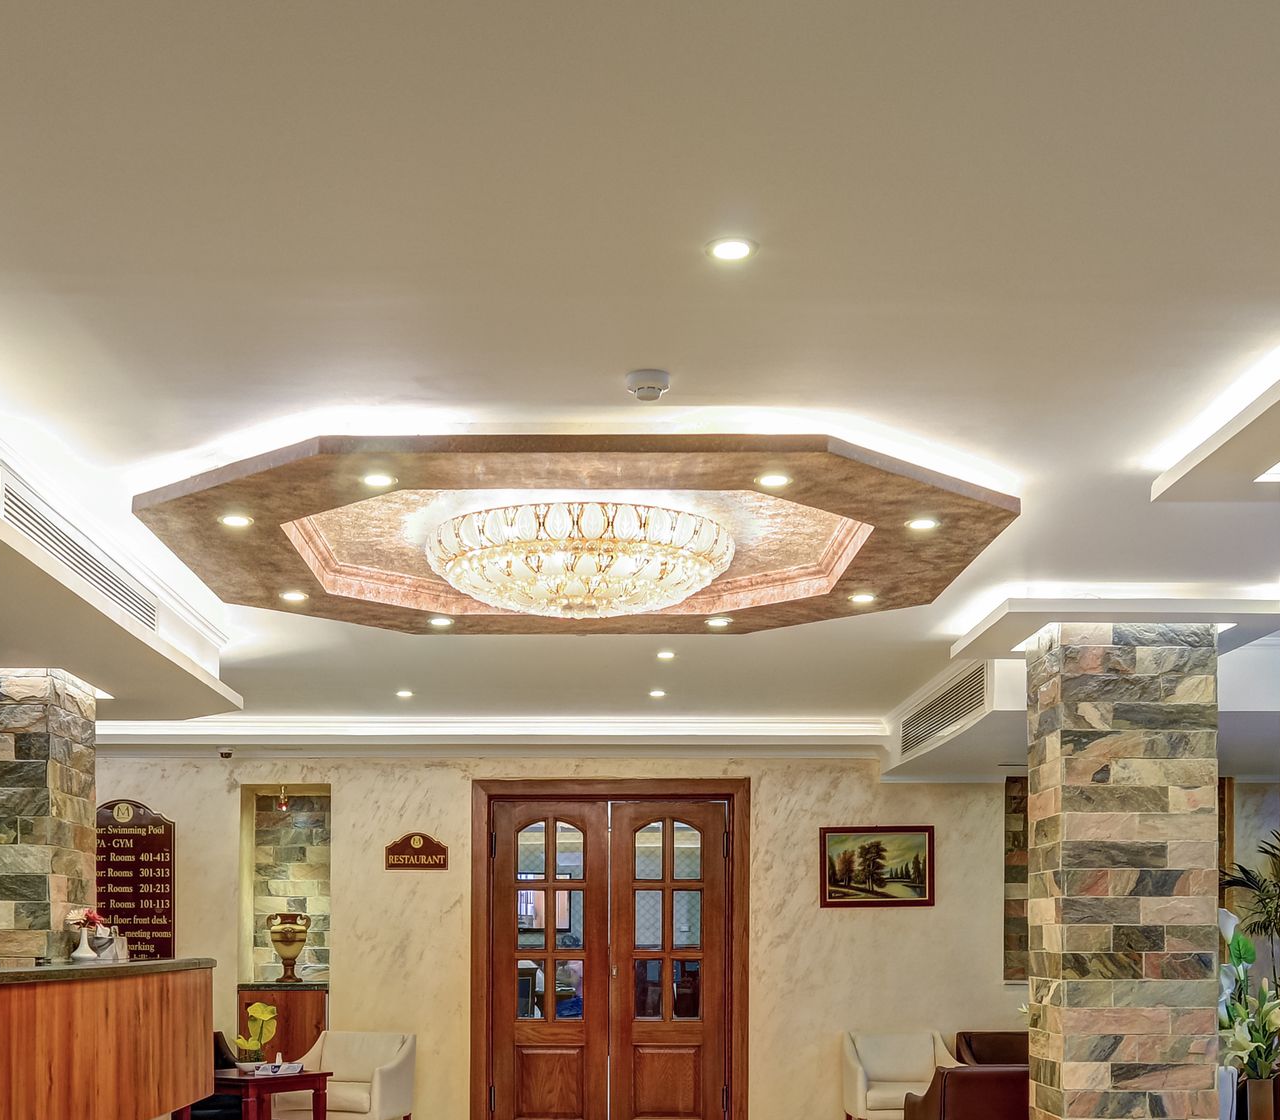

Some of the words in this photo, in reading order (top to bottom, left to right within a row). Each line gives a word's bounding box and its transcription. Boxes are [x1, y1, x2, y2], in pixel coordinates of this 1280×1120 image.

[107, 825, 146, 836] Swimming
[148, 825, 165, 834] Pool
[112, 839, 133, 848] GYM
[110, 853, 135, 862] Rooms
[140, 853, 170, 862] 401-413
[388, 855, 445, 864] RESTAURANT
[107, 868, 133, 877] Rooms
[140, 868, 170, 877] 301-313
[107, 884, 133, 893] Rooms
[140, 884, 170, 893] 201-213
[110, 900, 135, 908] Rooms
[140, 900, 170, 908] 101-113
[114, 915, 132, 924] floor:
[133, 915, 150, 924] front
[152, 915, 168, 924] desk
[125, 930, 151, 939] meeting
